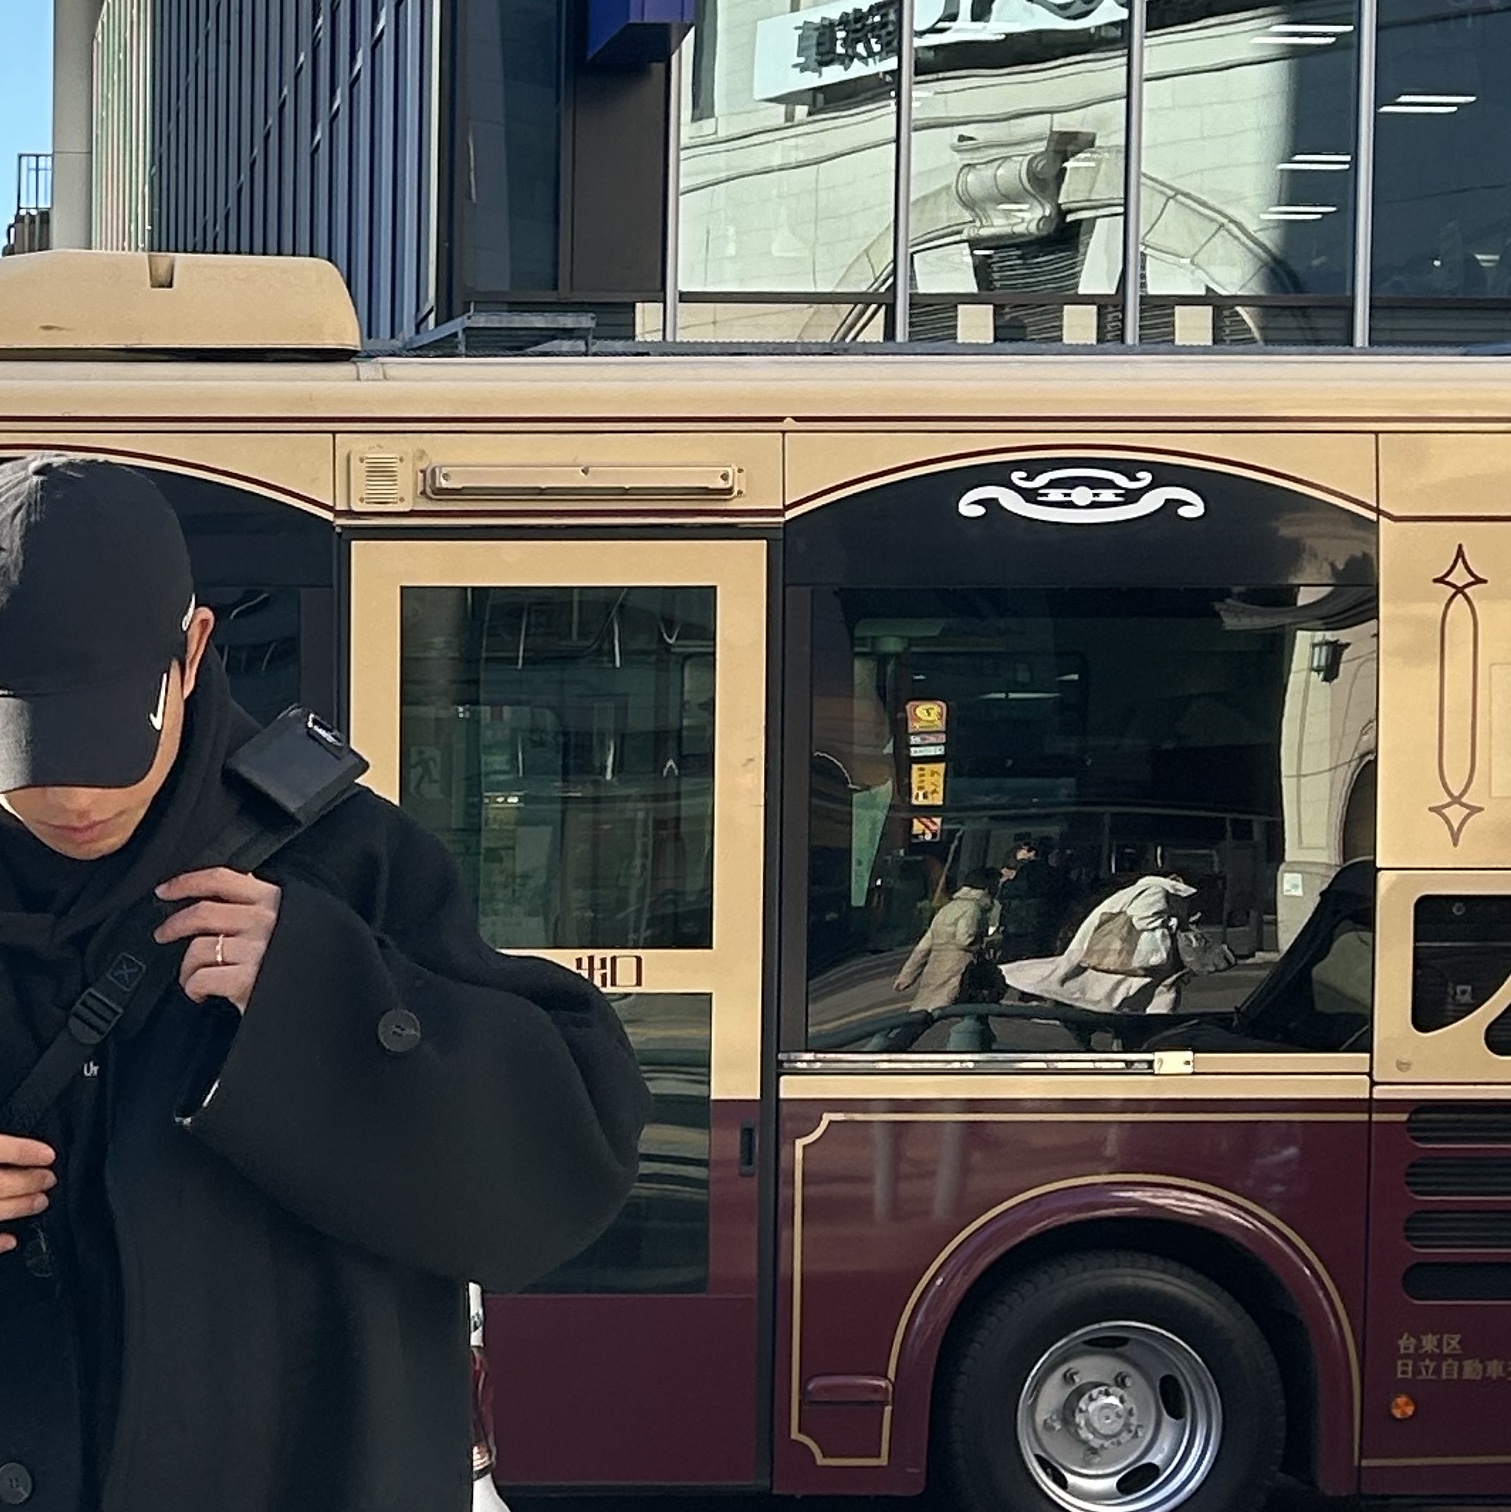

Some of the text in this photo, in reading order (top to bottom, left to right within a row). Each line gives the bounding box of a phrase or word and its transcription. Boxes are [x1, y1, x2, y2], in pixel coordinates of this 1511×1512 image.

[1399, 1333, 1462, 1354] 台東区
[1396, 1359, 1511, 1380] 日立自動車
